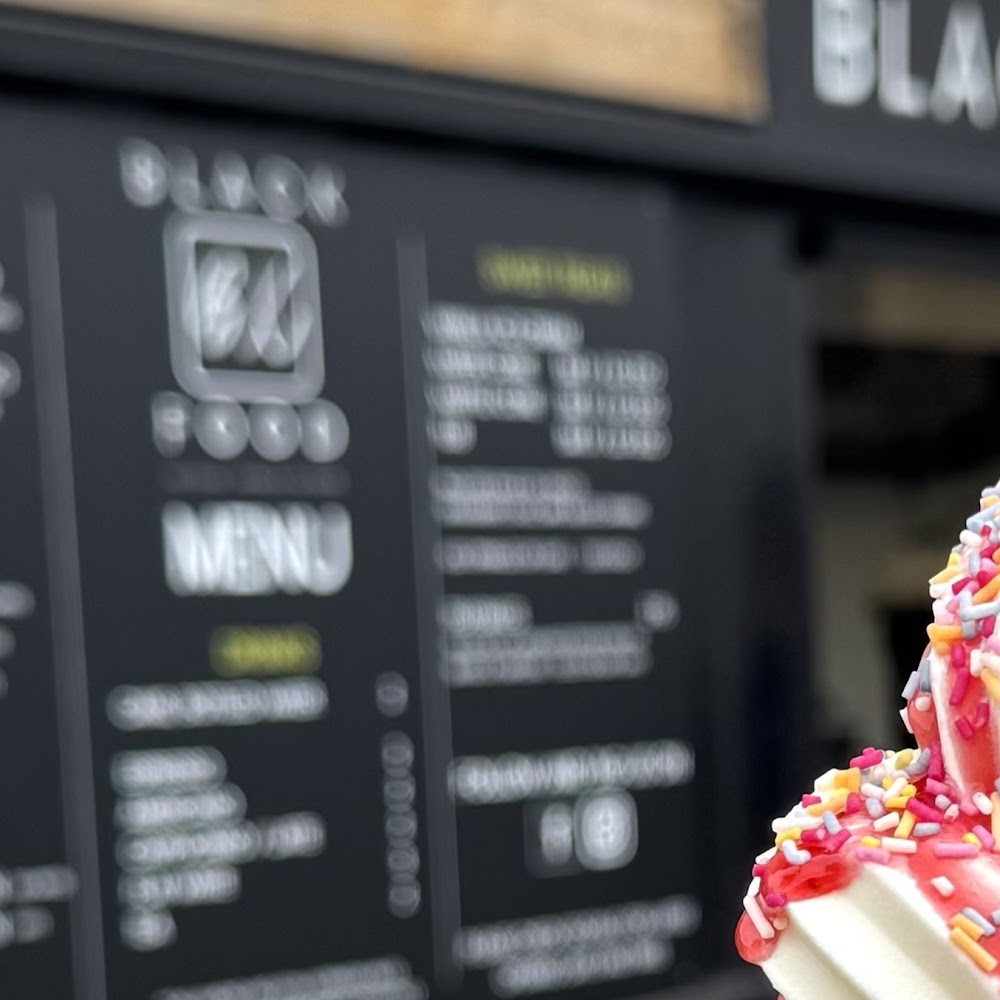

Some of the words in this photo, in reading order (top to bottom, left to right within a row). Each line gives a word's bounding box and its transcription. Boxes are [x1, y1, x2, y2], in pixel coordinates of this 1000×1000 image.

[119, 137, 349, 228] BLACK
[151, 390, 350, 463] FOOD
[162, 501, 353, 597] MENU
